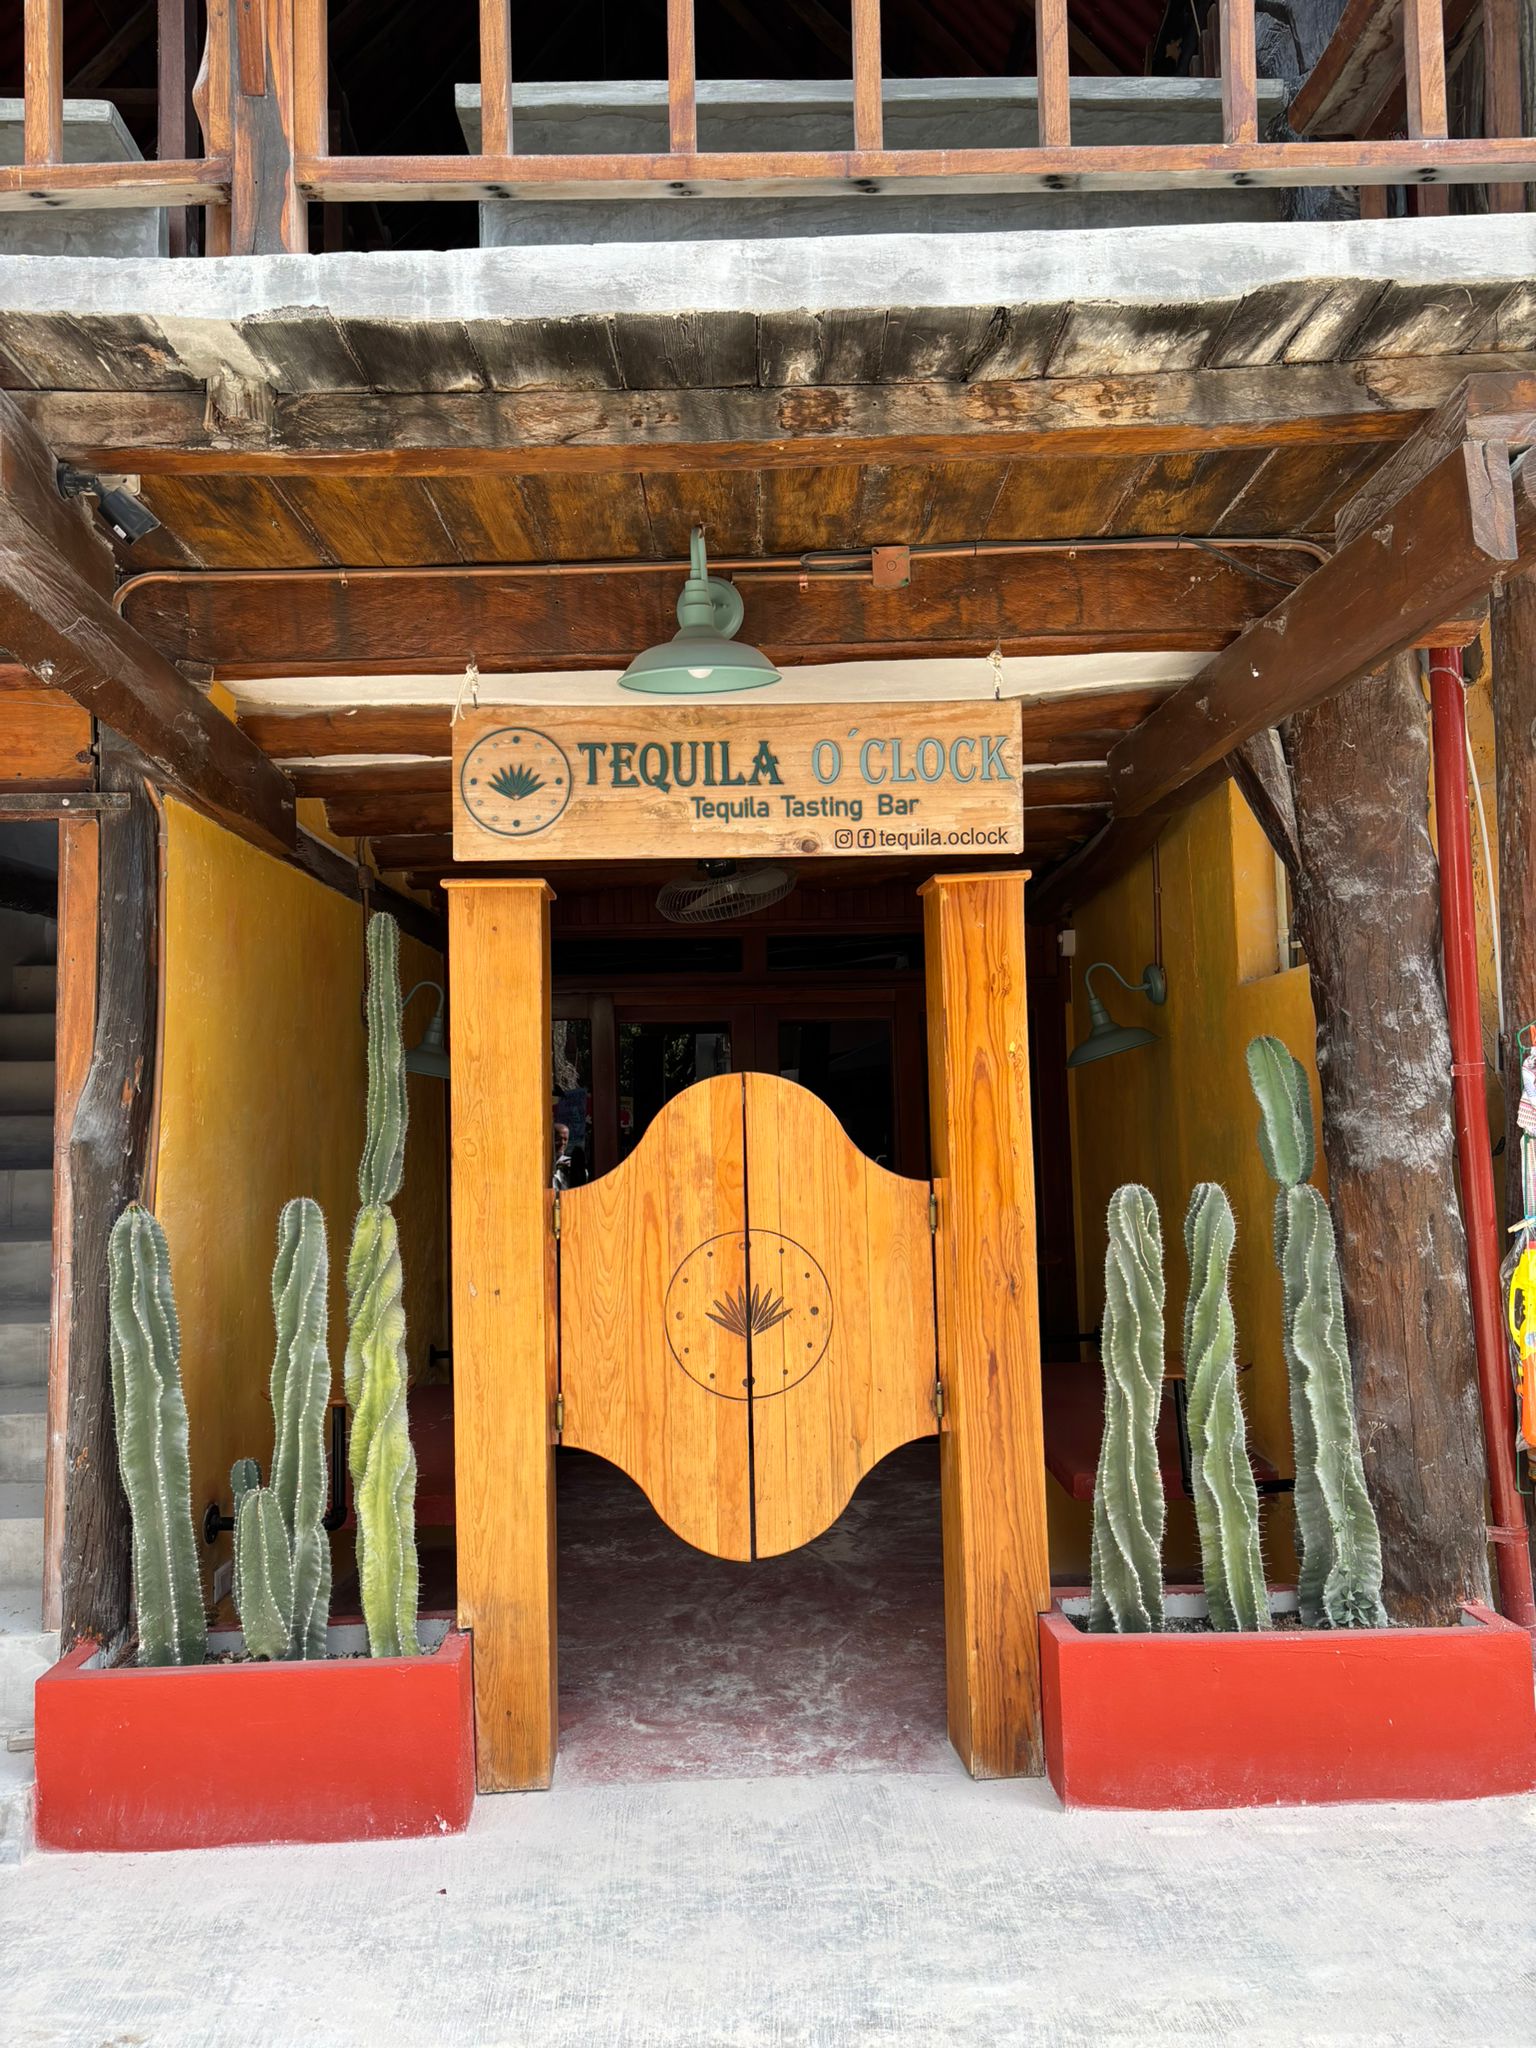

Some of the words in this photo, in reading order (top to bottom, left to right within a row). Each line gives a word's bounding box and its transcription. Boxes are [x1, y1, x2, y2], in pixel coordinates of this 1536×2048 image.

[577, 740, 784, 794] TEQUILA
[690, 796, 770, 824] Tequila
[780, 795, 863, 822] Tasting
[877, 793, 920, 816] Bar
[879, 827, 1009, 850] tequila.oclock
